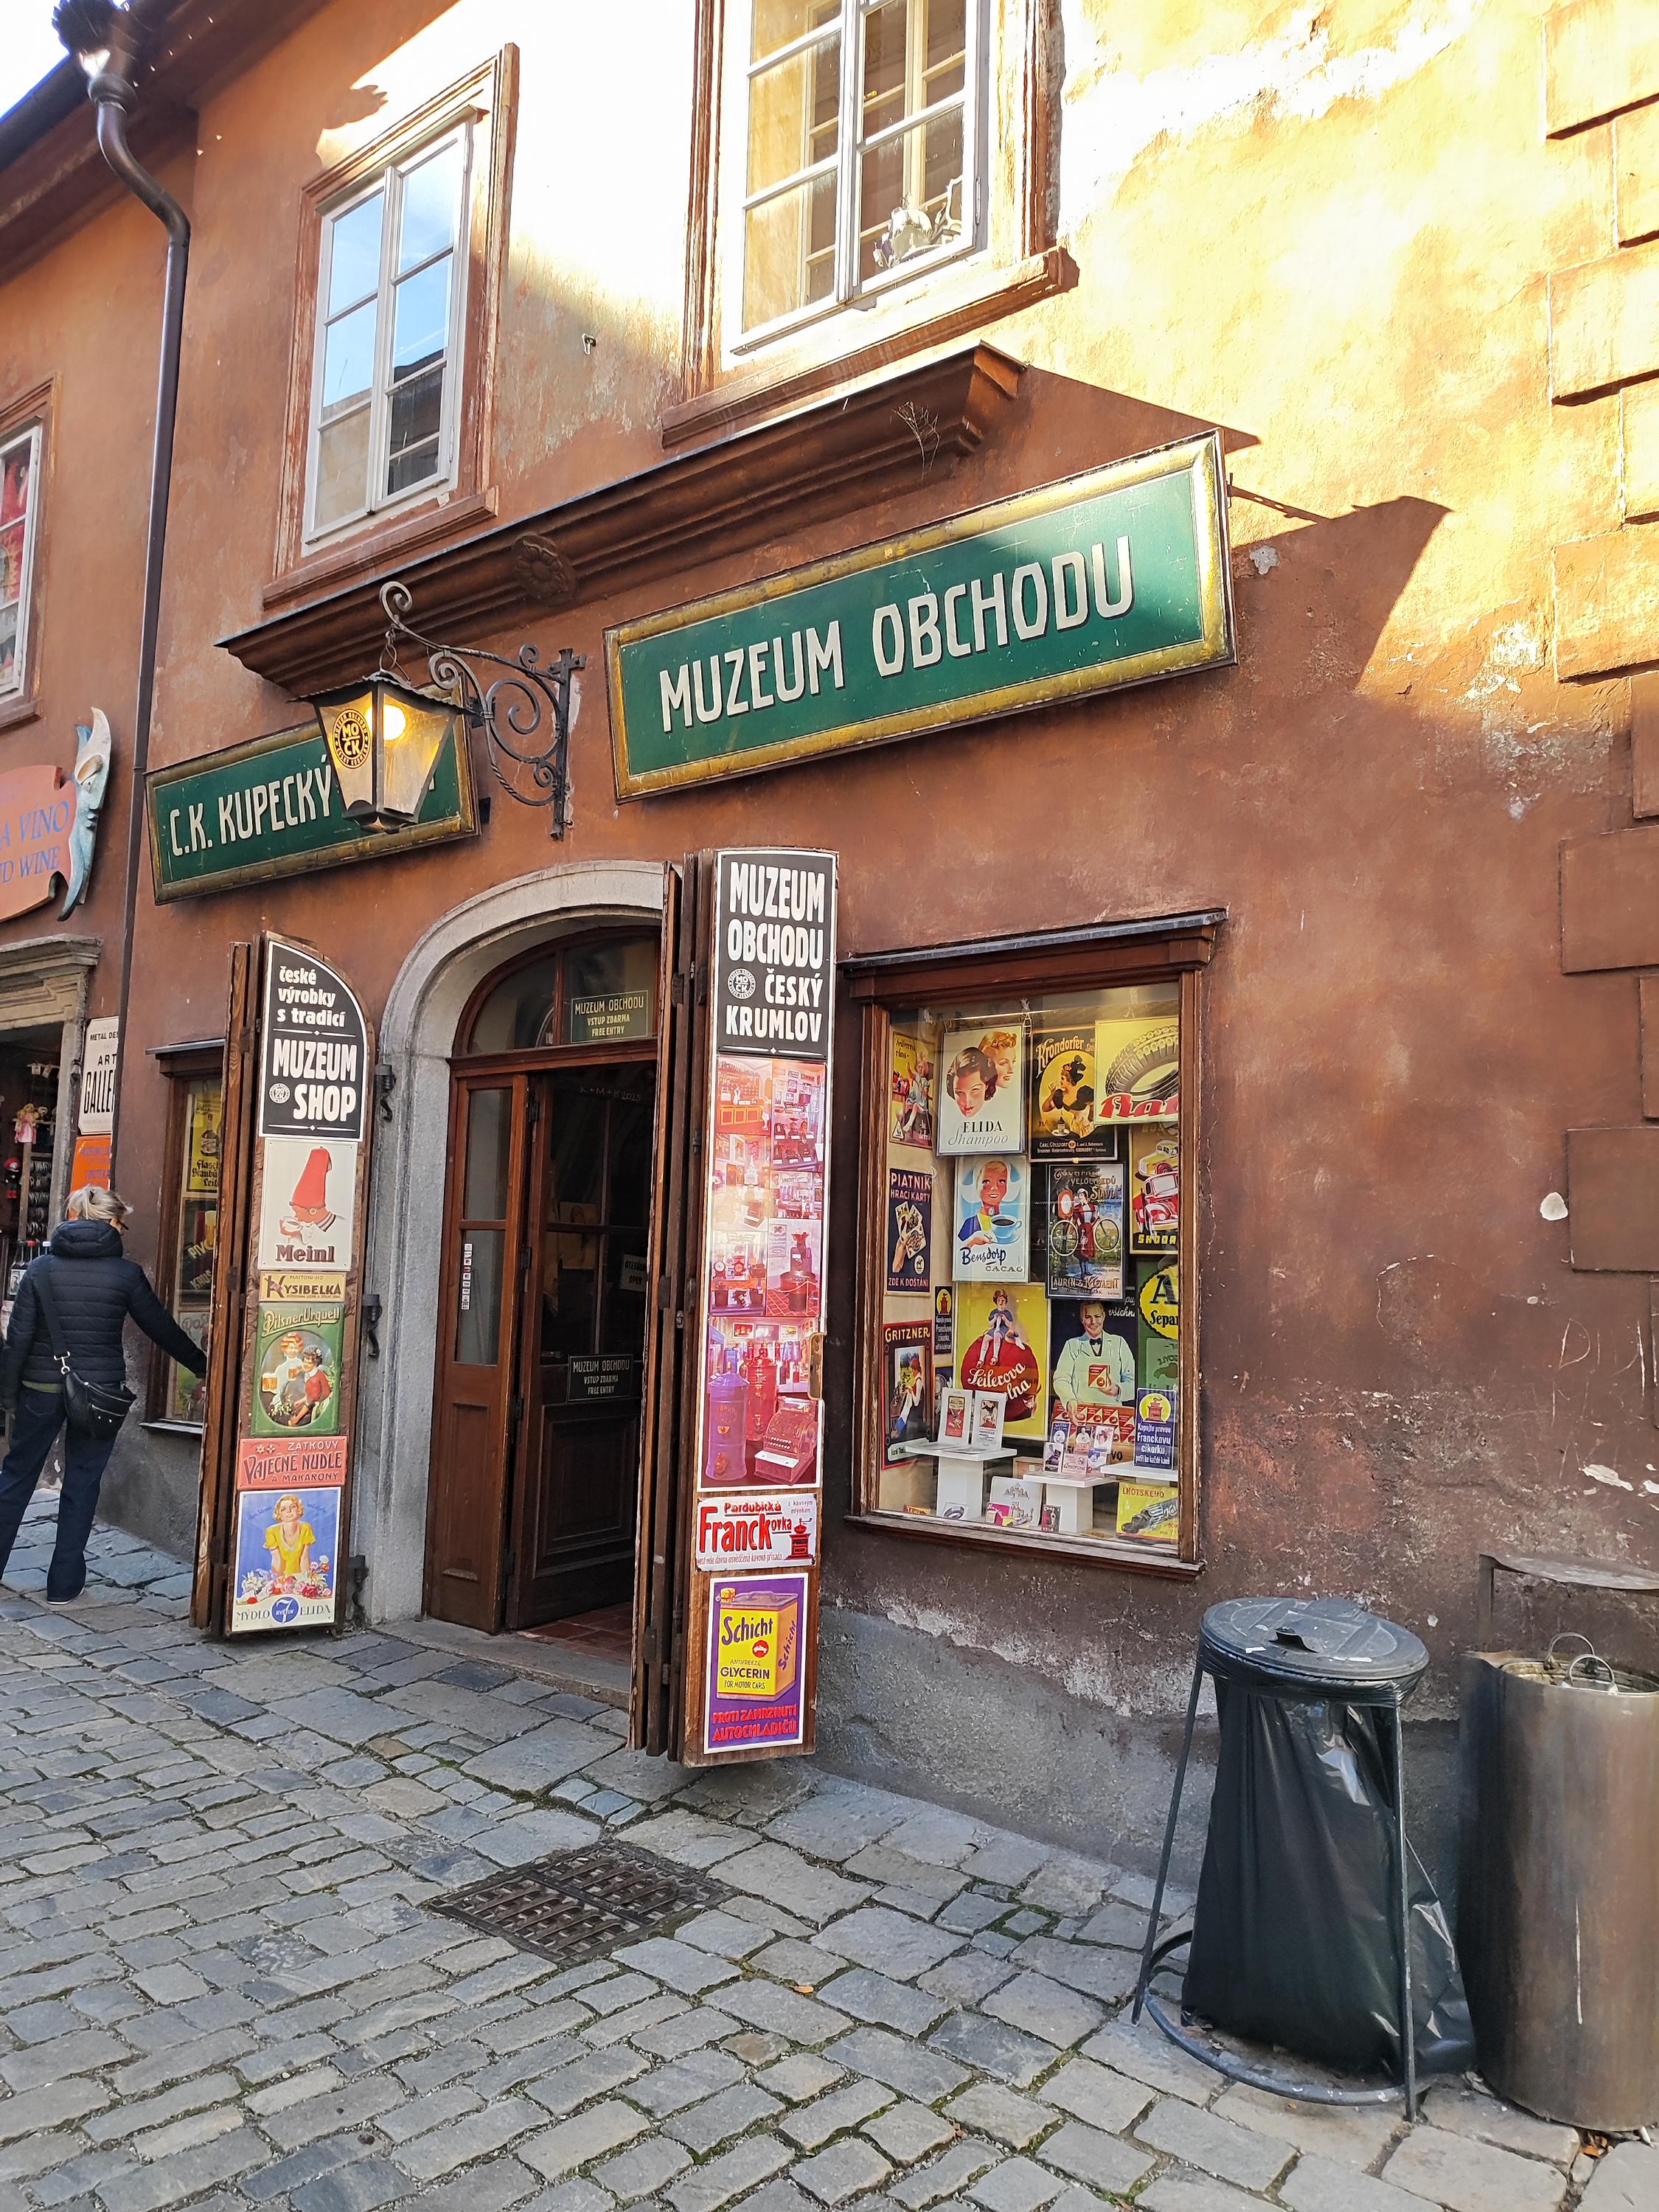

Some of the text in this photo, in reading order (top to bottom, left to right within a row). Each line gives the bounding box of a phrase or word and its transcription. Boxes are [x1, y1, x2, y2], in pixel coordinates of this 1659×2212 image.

[658, 535, 1134, 733] MUZEUM OBCHODU
[341, 723, 360, 737] MO
[344, 740, 361, 756] CK
[168, 756, 333, 858] C.K. KUPECKÝ
[19, 801, 71, 844] VÍNO
[19, 847, 61, 880] WINE
[729, 861, 826, 923] MUZEUM
[727, 919, 824, 970] OBCHODU
[279, 965, 317, 986] české
[277, 986, 336, 1008] výrobky
[765, 967, 824, 1008] ČESKÝ
[574, 996, 644, 1015] MUZEUM OBCHODU
[276, 1007, 347, 1028] s tradicí
[587, 1013, 630, 1026] VSTUP ZDARMA
[726, 1004, 823, 1043] KRUMLOV
[90, 1032, 107, 1041] METAL
[591, 1026, 625, 1037] FREE ENTRY
[97, 1053, 116, 1066] ART
[273, 1038, 358, 1082] MUZEUM
[1035, 1035, 1085, 1079] Krondorfer
[83, 1069, 115, 1115] GALLE
[293, 1084, 357, 1122] SHOP
[947, 1124, 1009, 1148] Shampoo
[961, 1120, 1003, 1134] ELIDA
[890, 1172, 931, 1192] PIATNIK
[911, 1190, 931, 1204] KARTY
[275, 1244, 335, 1263] Meinl
[959, 1245, 1006, 1267] Bensdorp
[985, 1265, 1023, 1273] CACAO
[263, 1274, 342, 1298] KYSIBELKA
[888, 1277, 900, 1287] ZDE
[899, 1277, 905, 1287] K
[262, 1307, 340, 1333] Pilsner Urquell
[885, 1326, 931, 1343] GRITZNER
[573, 1358, 630, 1373] MUZEUM OBCHODU
[584, 1376, 599, 1385] VSTUP
[588, 1385, 615, 1395] FREE ENTRY
[1137, 1432, 1171, 1446] Franckovu
[302, 1450, 343, 1470] NUDLE
[282, 1472, 340, 1483] MAKARONY
[236, 1608, 271, 1622] MÝDLO
[299, 1604, 331, 1617] ELIDA
[721, 1615, 774, 1646] Schicht
[777, 1619, 798, 1671] Schicht
[729, 1658, 762, 1667] ANTIFREEZE
[720, 1666, 771, 1680] GLYCERIN
[724, 1680, 766, 1690] FOR MOTOR CARS
